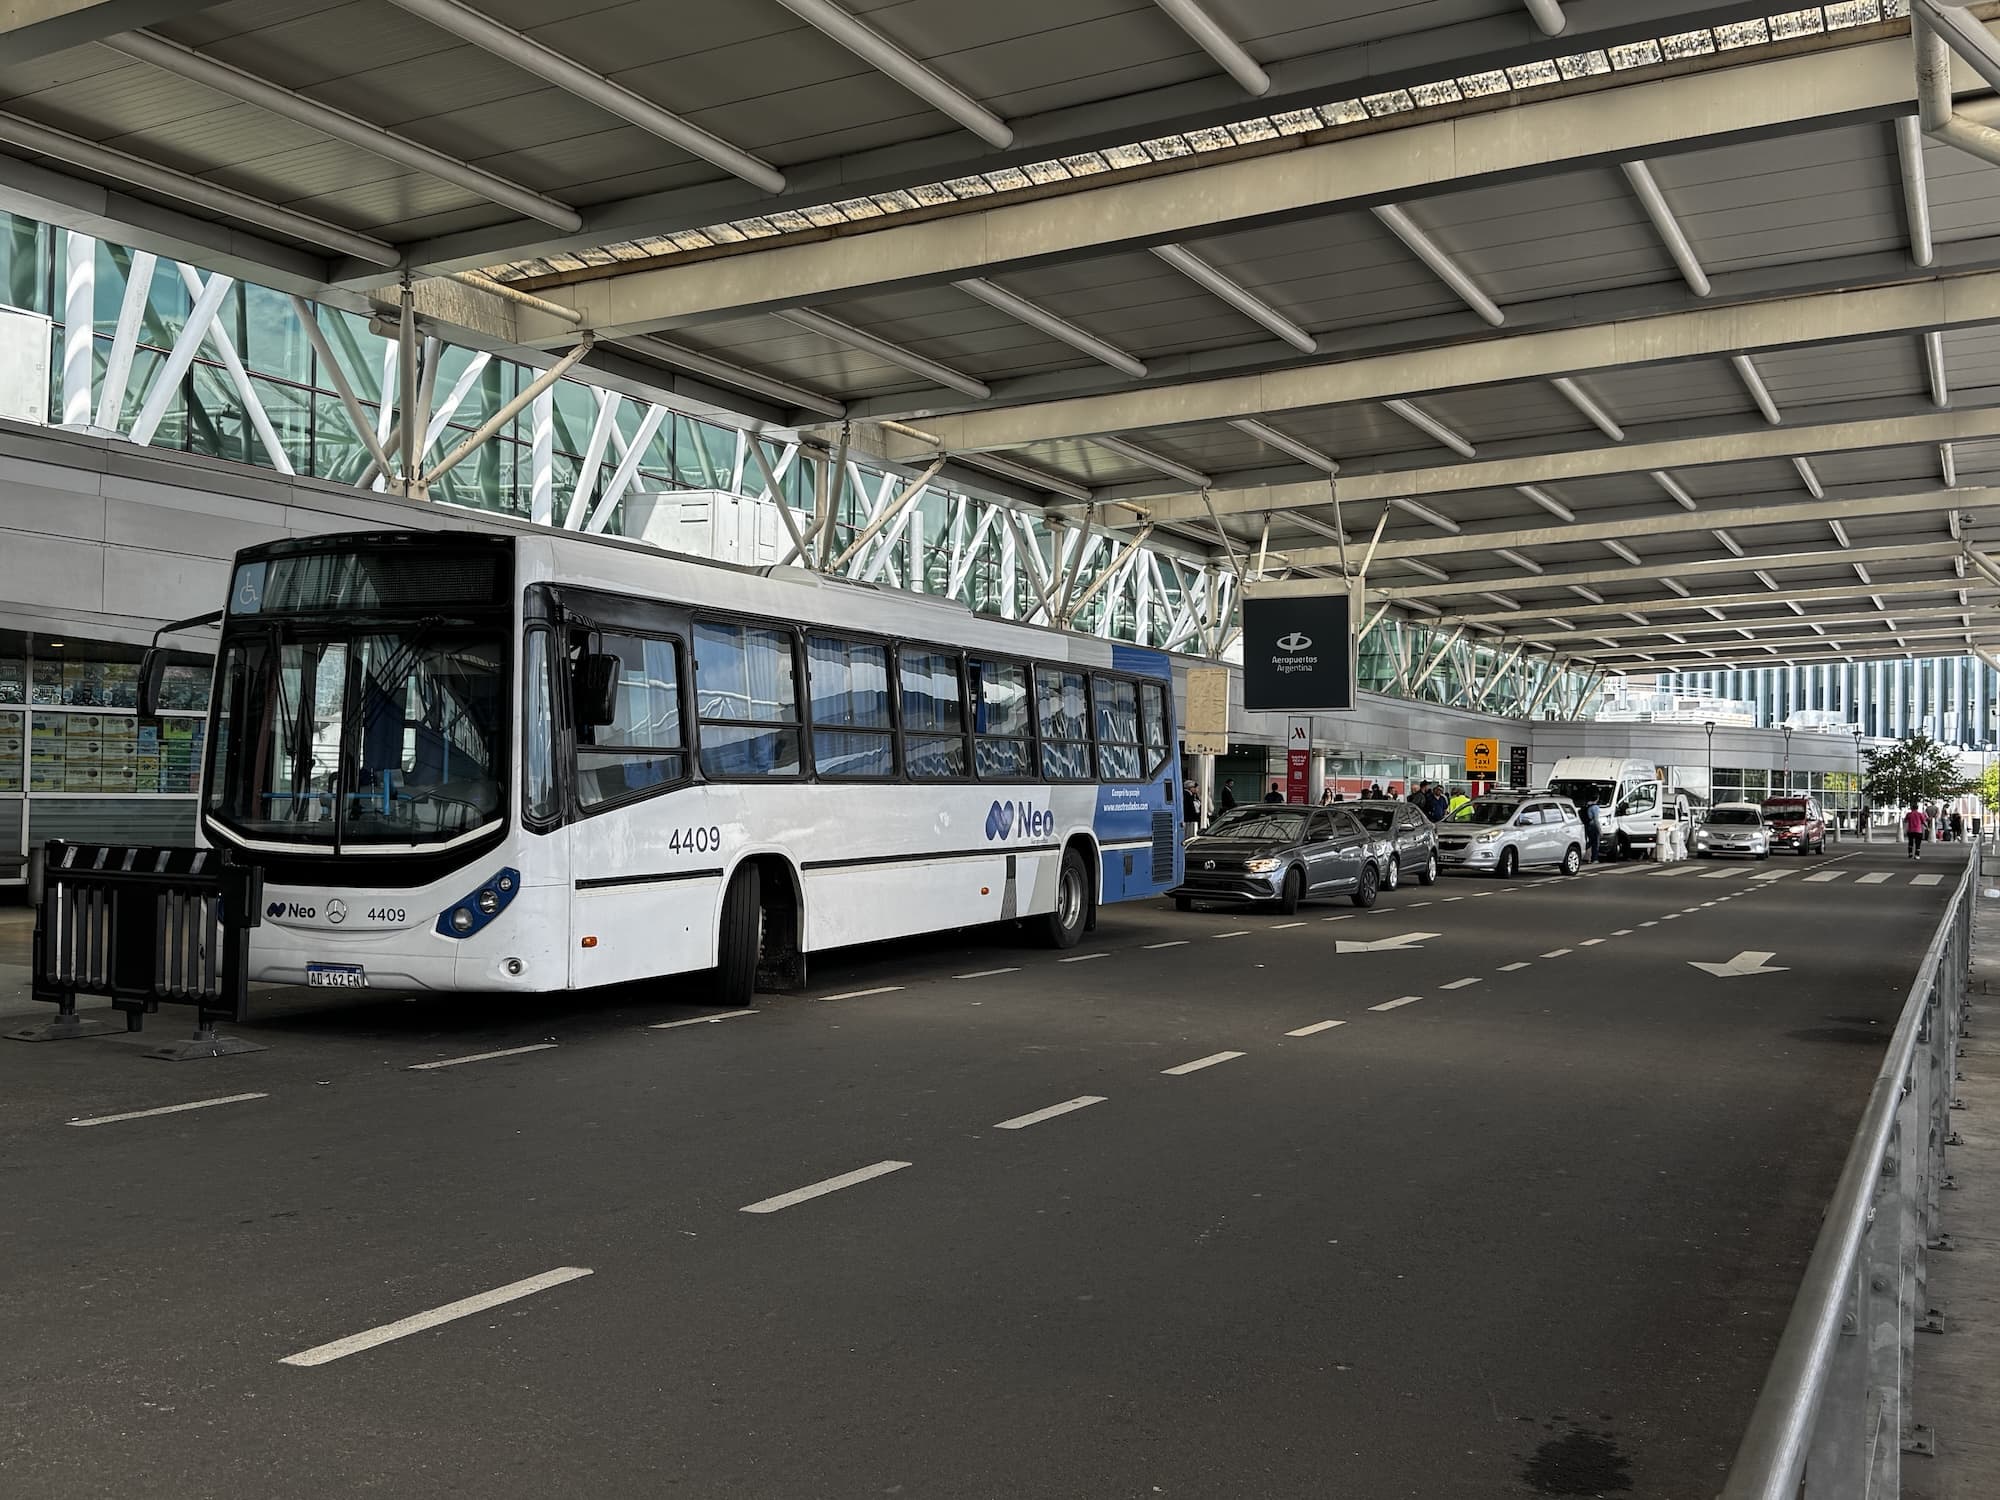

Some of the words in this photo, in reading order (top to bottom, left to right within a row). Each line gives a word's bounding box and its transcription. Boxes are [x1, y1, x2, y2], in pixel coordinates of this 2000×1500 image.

[1272, 656, 1318, 665] Aeropuertos
[1277, 664, 1312, 673] Argentina
[1018, 801, 1054, 838] Neo
[669, 826, 720, 854] 4409
[288, 903, 316, 918] Neo
[367, 908, 406, 922] 4409
[311, 972, 323, 985] AD
[326, 973, 345, 985] 162
